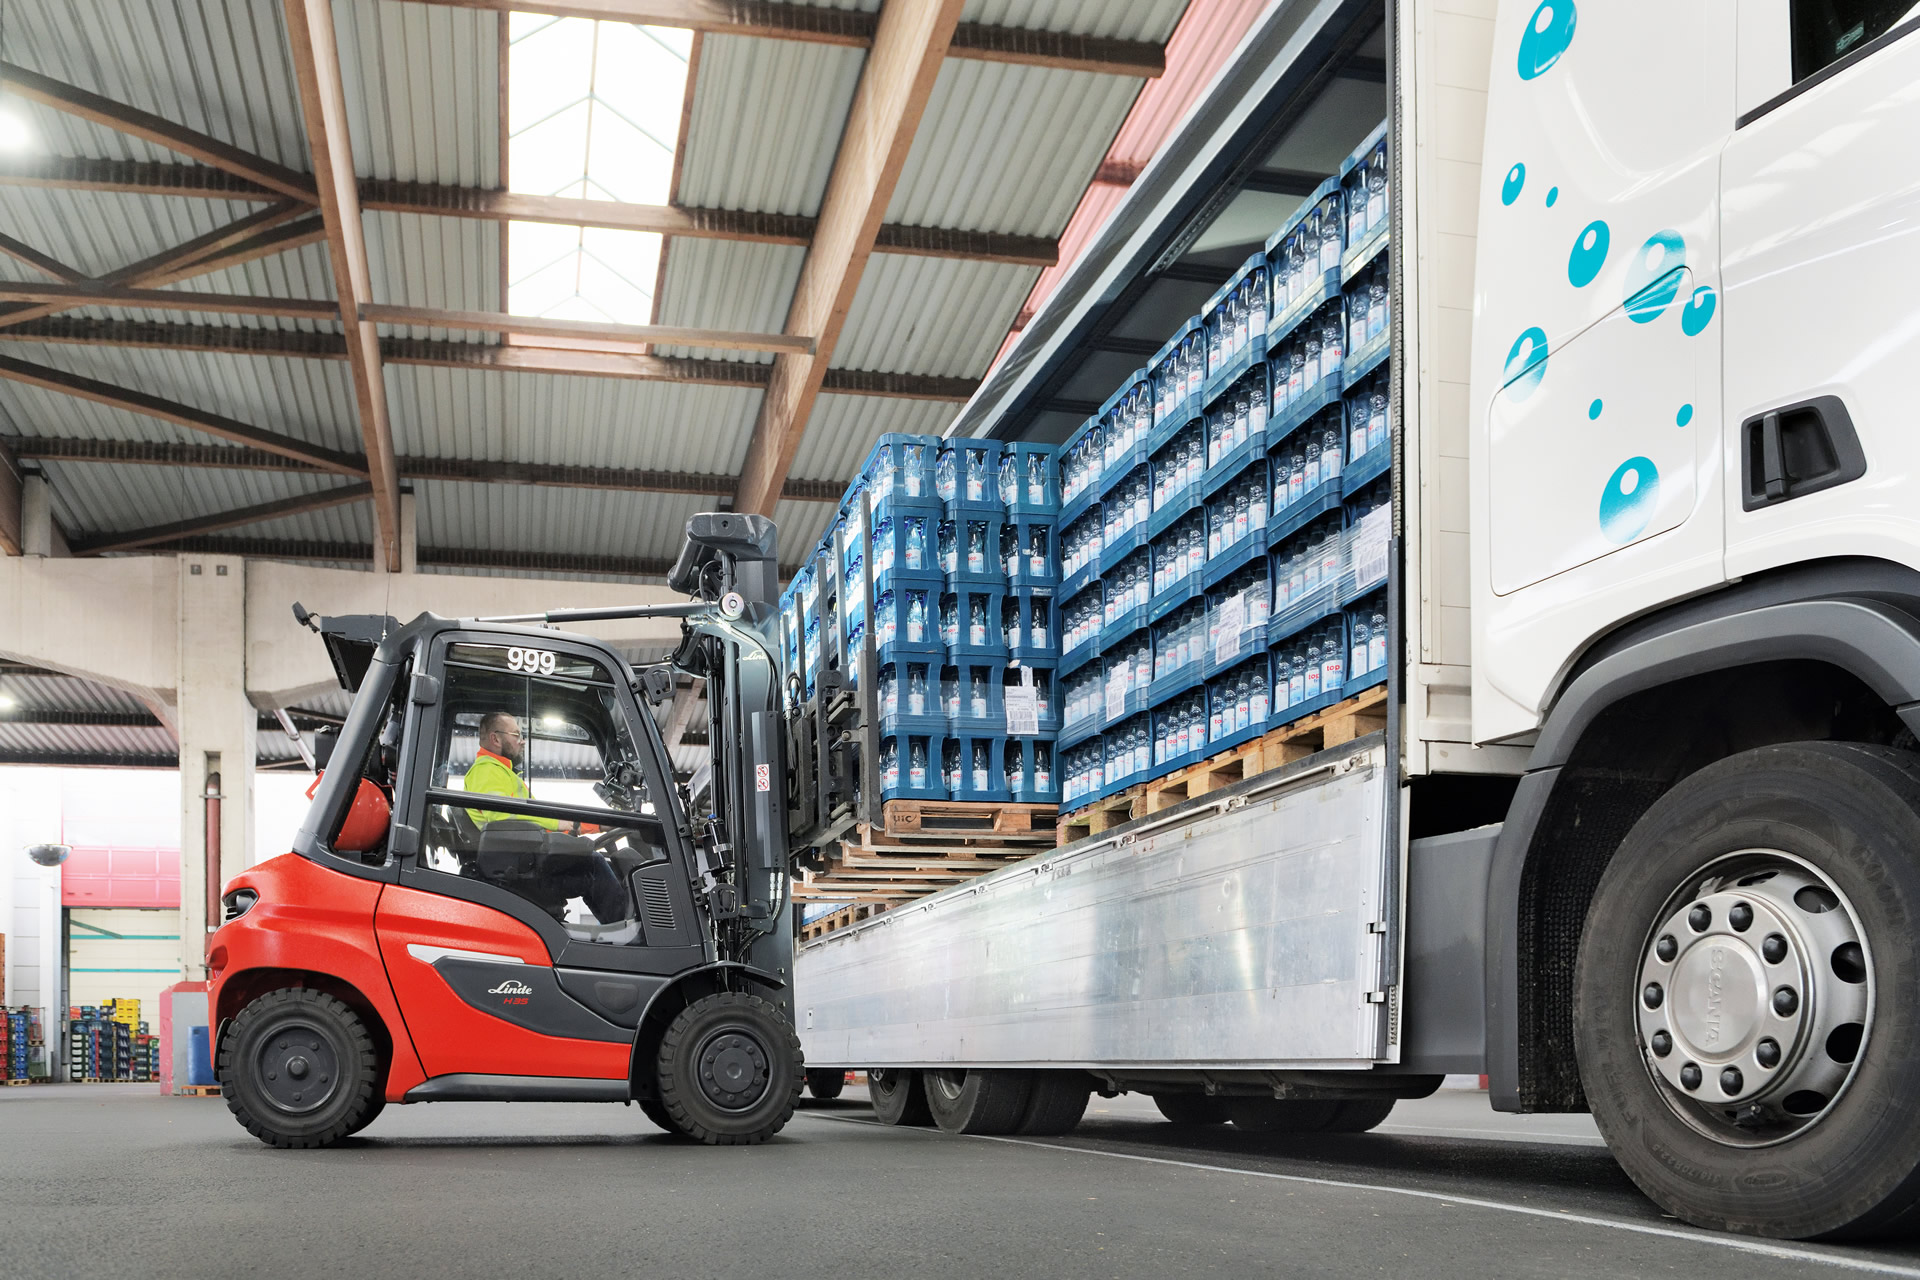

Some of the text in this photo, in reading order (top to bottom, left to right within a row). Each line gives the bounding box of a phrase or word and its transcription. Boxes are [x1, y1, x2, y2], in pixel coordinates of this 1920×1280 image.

[1290, 477, 1302, 485] top
[507, 646, 556, 675] 999
[487, 979, 533, 995] Linde
[1704, 948, 1725, 1048] SCANIA
